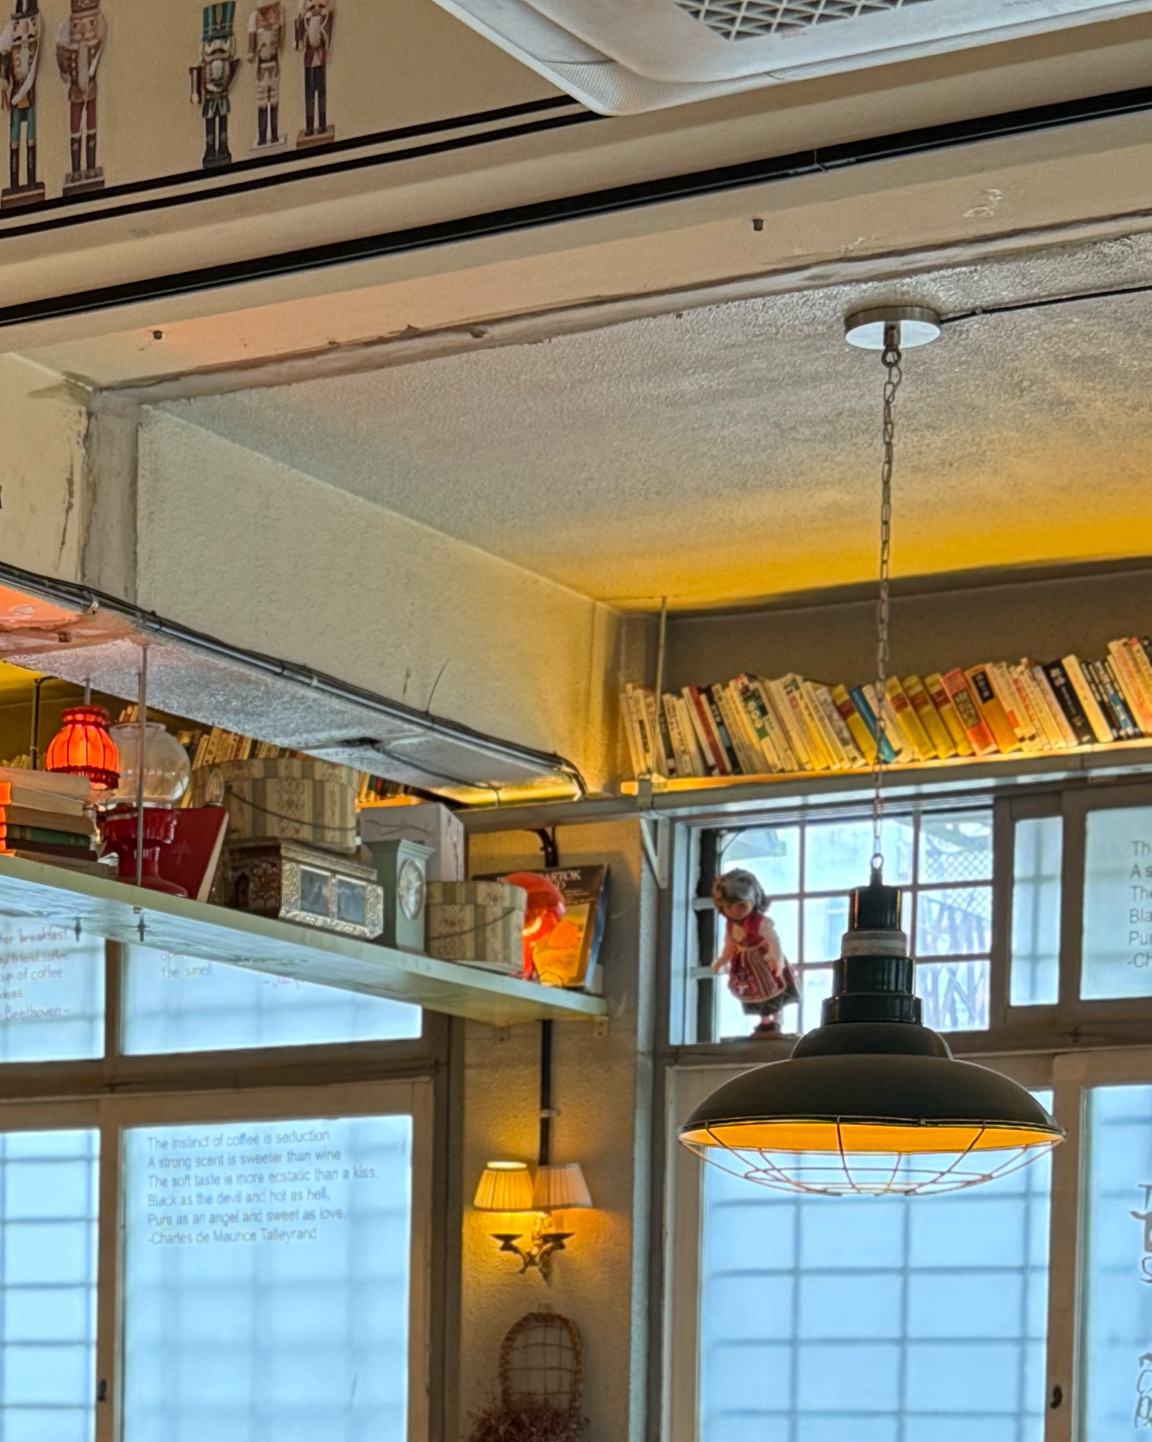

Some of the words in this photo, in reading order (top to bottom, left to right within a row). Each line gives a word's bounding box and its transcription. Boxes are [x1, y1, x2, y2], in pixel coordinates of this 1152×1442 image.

[0, 931, 14, 945] for
[31, 965, 63, 981] coffee
[186, 962, 213, 977] smell
[147, 1136, 168, 1150] The
[172, 1135, 209, 1150] instinct
[213, 1133, 223, 1147] of
[227, 1132, 260, 1147] coffee
[263, 1132, 272, 1144] is
[276, 1129, 330, 1144] seduction
[147, 1156, 156, 1169] A
[159, 1156, 192, 1171] strong
[195, 1153, 224, 1167] scent
[227, 1154, 237, 1166] is
[240, 1151, 282, 1165] sweeter
[287, 1149, 311, 1163] than
[315, 1148, 341, 1161] wine
[147, 1174, 168, 1188] The
[171, 1174, 191, 1187] soft
[195, 1174, 220, 1187] taste
[224, 1172, 233, 1185] is
[236, 1172, 265, 1185] more
[268, 1168, 311, 1183] ecstatic
[314, 1167, 339, 1181] than
[342, 1169, 350, 1180] a
[148, 1193, 176, 1207] Black
[180, 1195, 193, 1206] as
[196, 1192, 213, 1205] the
[217, 1190, 242, 1205] devil
[245, 1189, 266, 1203] and
[270, 1188, 287, 1202] hot
[290, 1191, 303, 1202] as
[148, 1212, 173, 1226] Pure
[176, 1214, 189, 1225] as
[192, 1213, 205, 1224] an
[209, 1210, 239, 1226] angel
[243, 1209, 263, 1224] and
[267, 1208, 299, 1222] sweet
[302, 1209, 316, 1221] as
[196, 1230, 209, 1243] de
[213, 1229, 257, 1242] Maurice
[262, 1226, 317, 1244] Talleyrand
